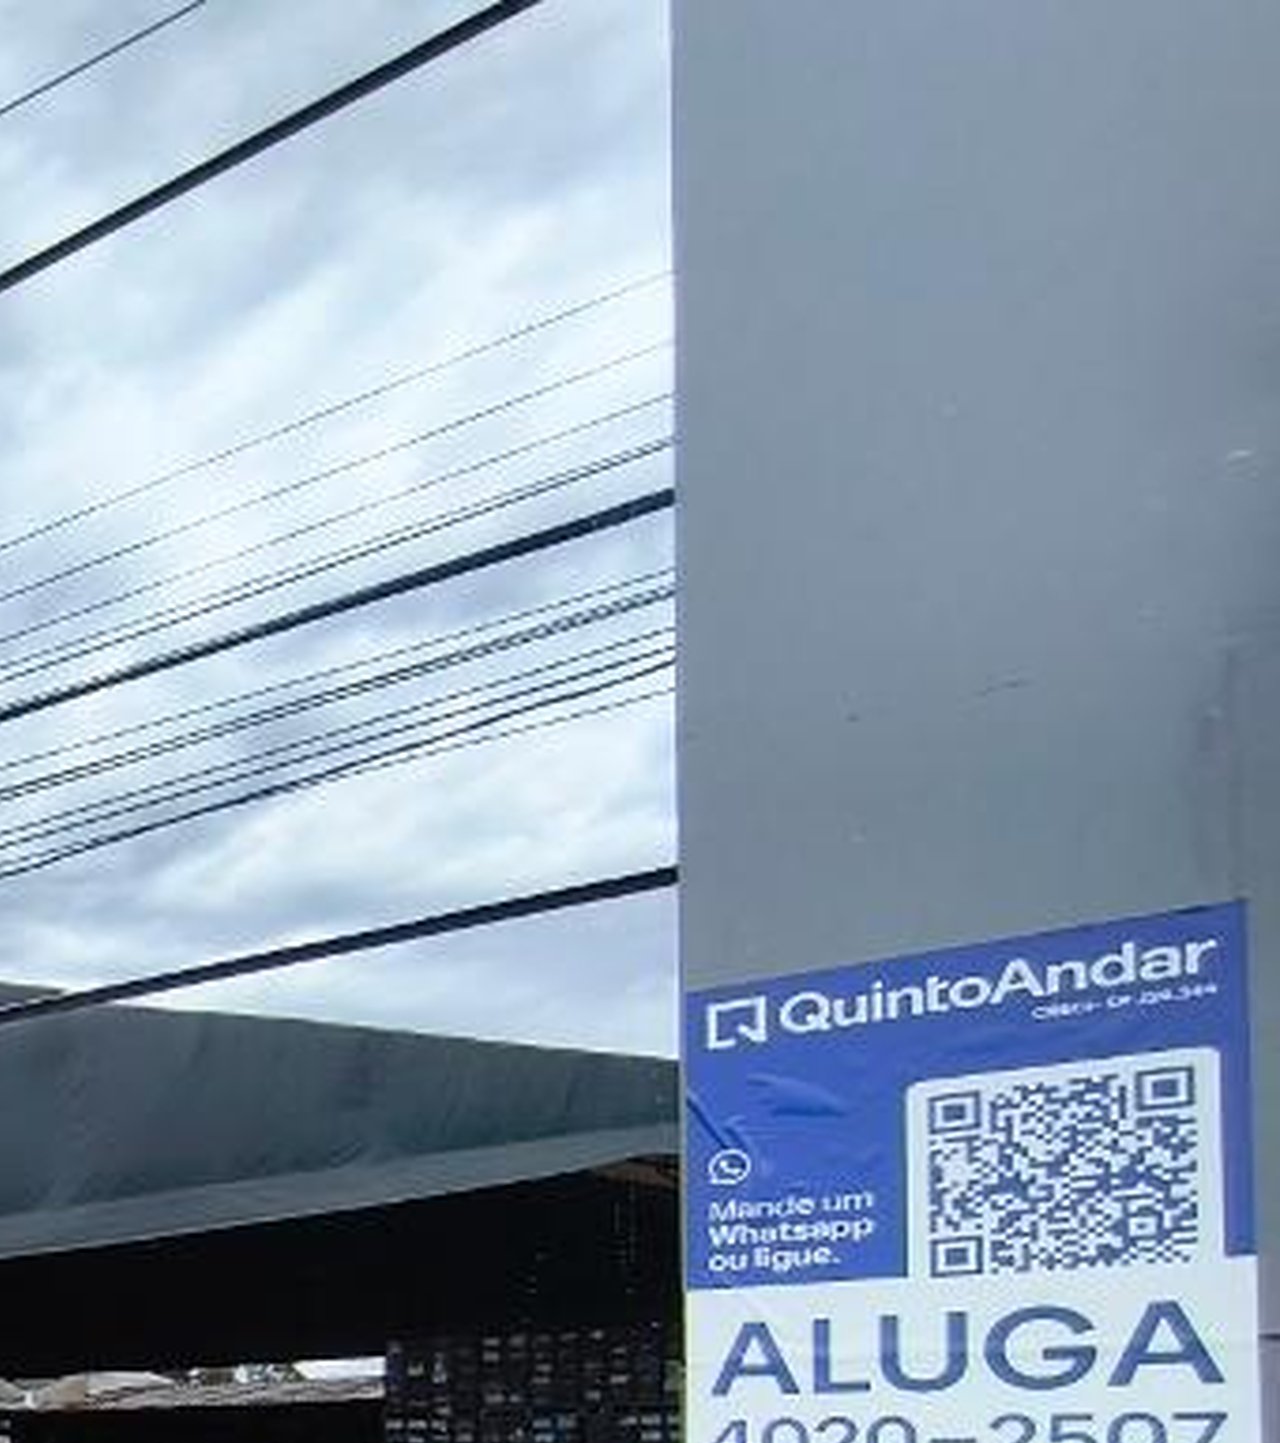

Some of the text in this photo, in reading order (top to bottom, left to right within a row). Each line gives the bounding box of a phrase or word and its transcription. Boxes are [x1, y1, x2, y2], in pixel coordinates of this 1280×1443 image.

[780, 938, 1218, 1036] QuintoAndar
[708, 1190, 874, 1222] Mande um
[708, 1217, 875, 1247] Whatsapp
[708, 1246, 841, 1272] ou ligue.
[711, 1300, 1226, 1397] ALUGA
